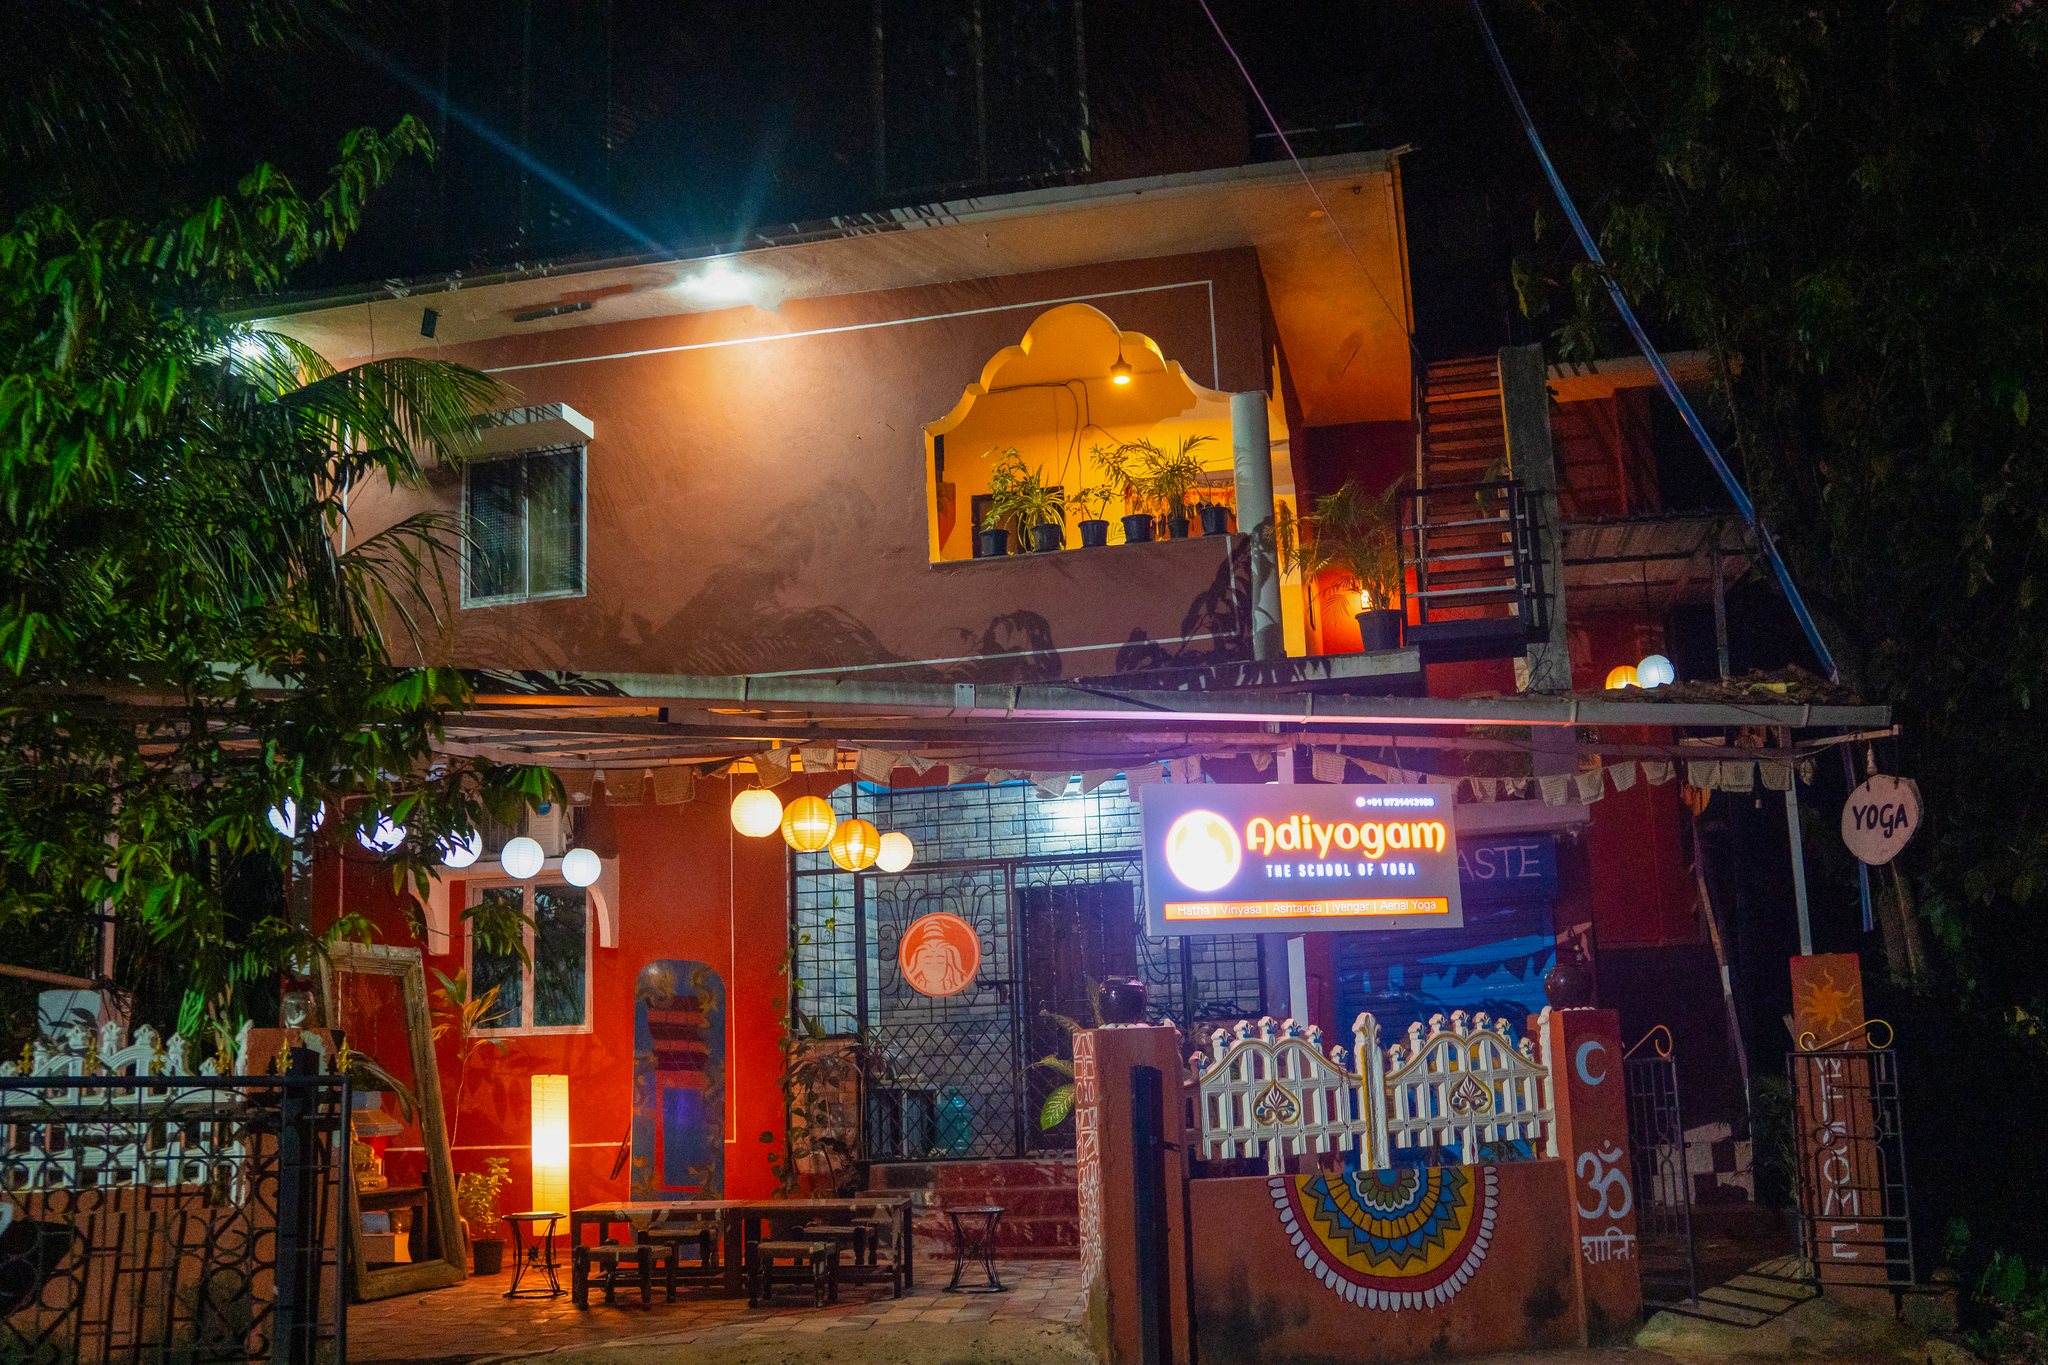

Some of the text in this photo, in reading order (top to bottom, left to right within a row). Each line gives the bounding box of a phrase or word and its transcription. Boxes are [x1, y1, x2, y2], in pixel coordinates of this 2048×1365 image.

[1852, 803, 1909, 838] YOGA
[1246, 814, 1446, 860] Adiyogam
[1265, 862, 1416, 878] THE SCHOOL OF YOGA
[1176, 900, 1437, 917] Hatha Vinyasa Ashtanga Iyengar Aerial Yoga
